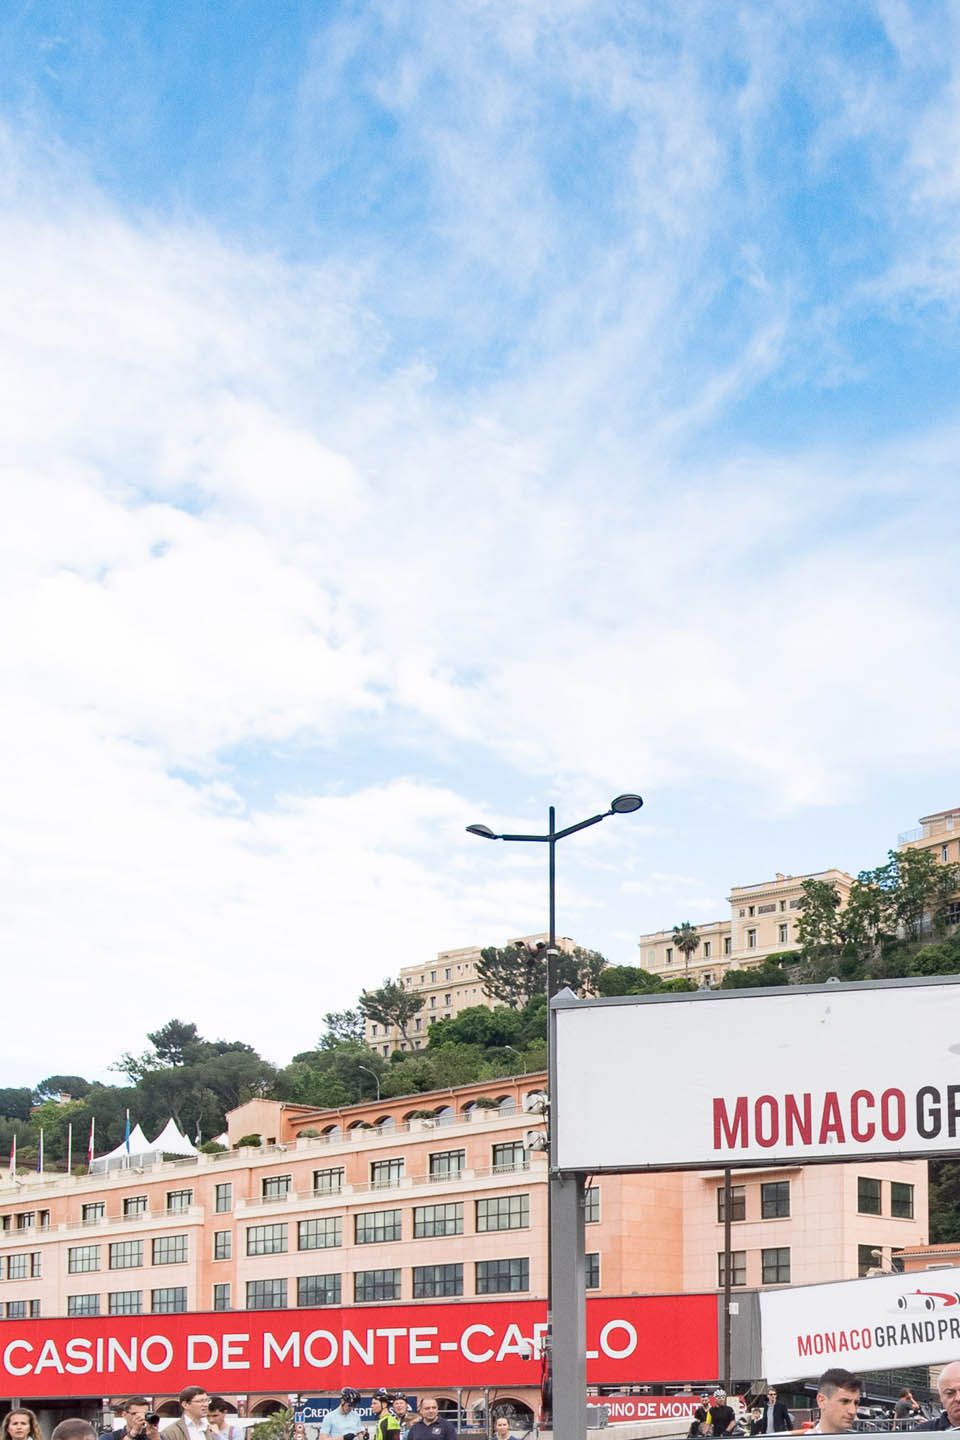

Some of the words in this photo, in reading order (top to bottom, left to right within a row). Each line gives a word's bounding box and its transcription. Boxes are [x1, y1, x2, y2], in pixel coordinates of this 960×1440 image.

[3, 1335, 174, 1376] CASINO
[187, 1334, 250, 1371] DE
[637, 1402, 657, 1416] DE
